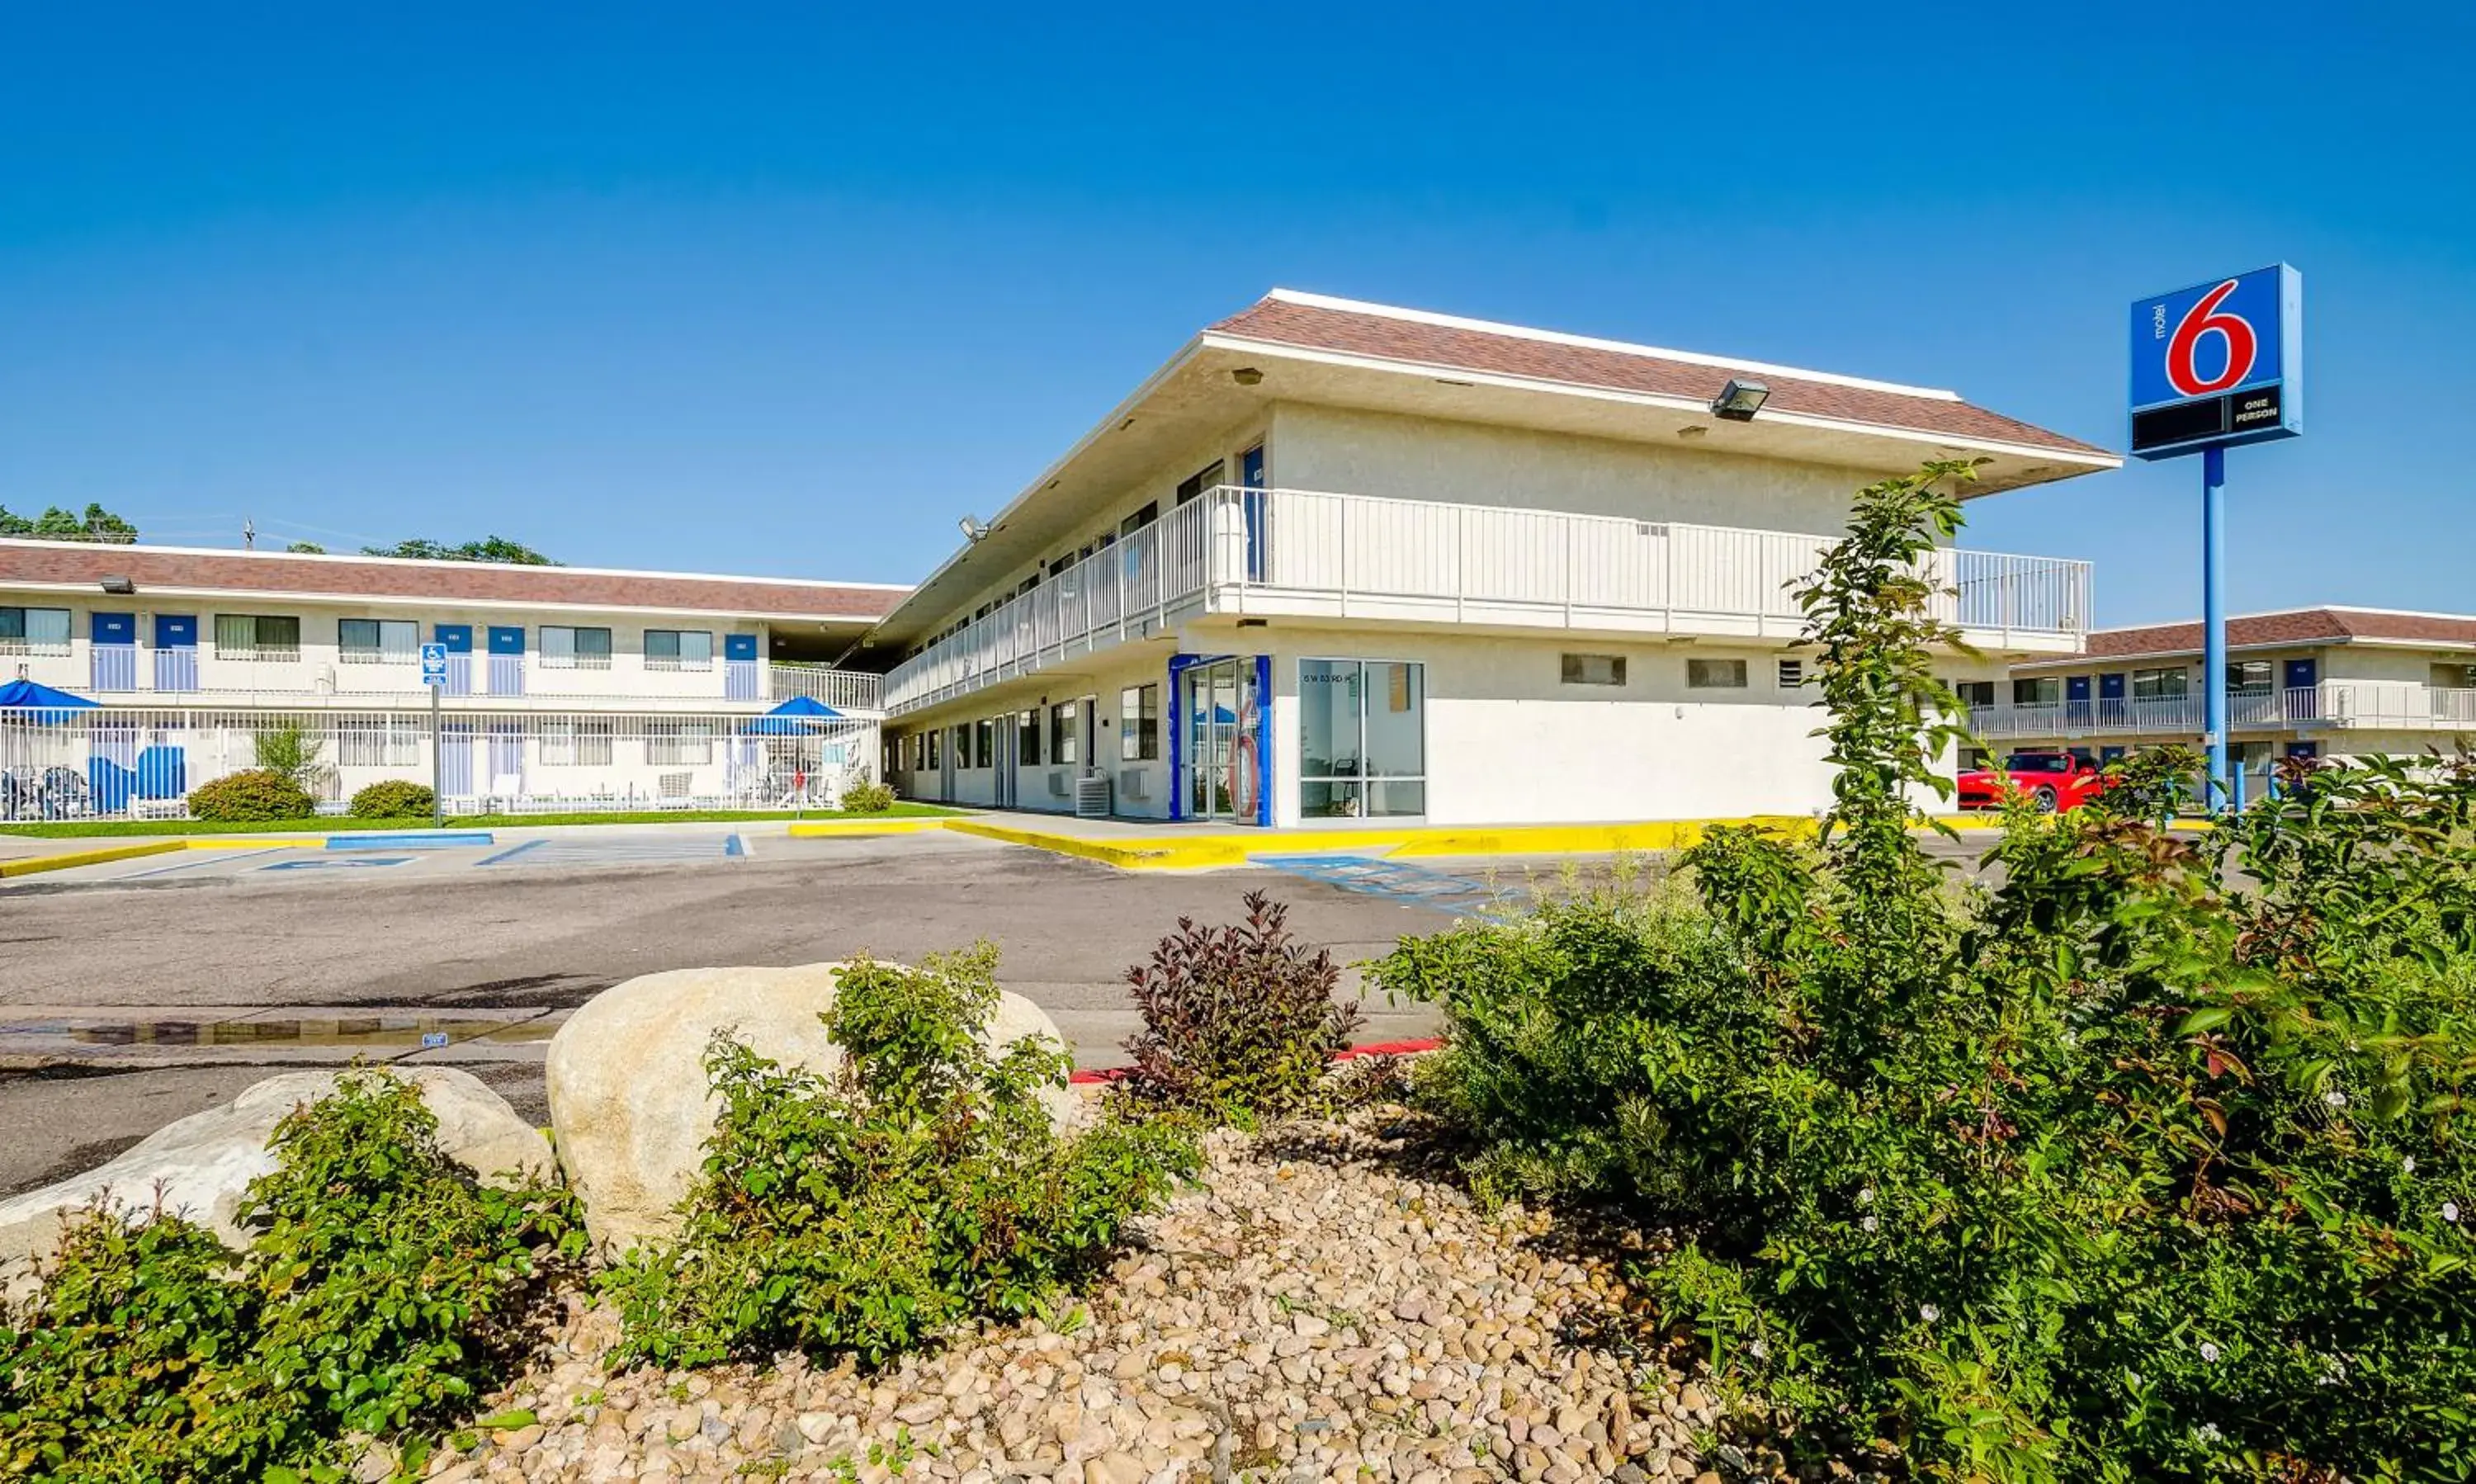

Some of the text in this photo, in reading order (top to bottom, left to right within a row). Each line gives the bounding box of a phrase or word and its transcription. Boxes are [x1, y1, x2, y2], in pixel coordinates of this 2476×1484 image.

[2152, 304, 2166, 339] motel
[2166, 279, 2257, 396] 6
[2236, 407, 2277, 423] PERSON
[2244, 398, 2269, 410] ONE
